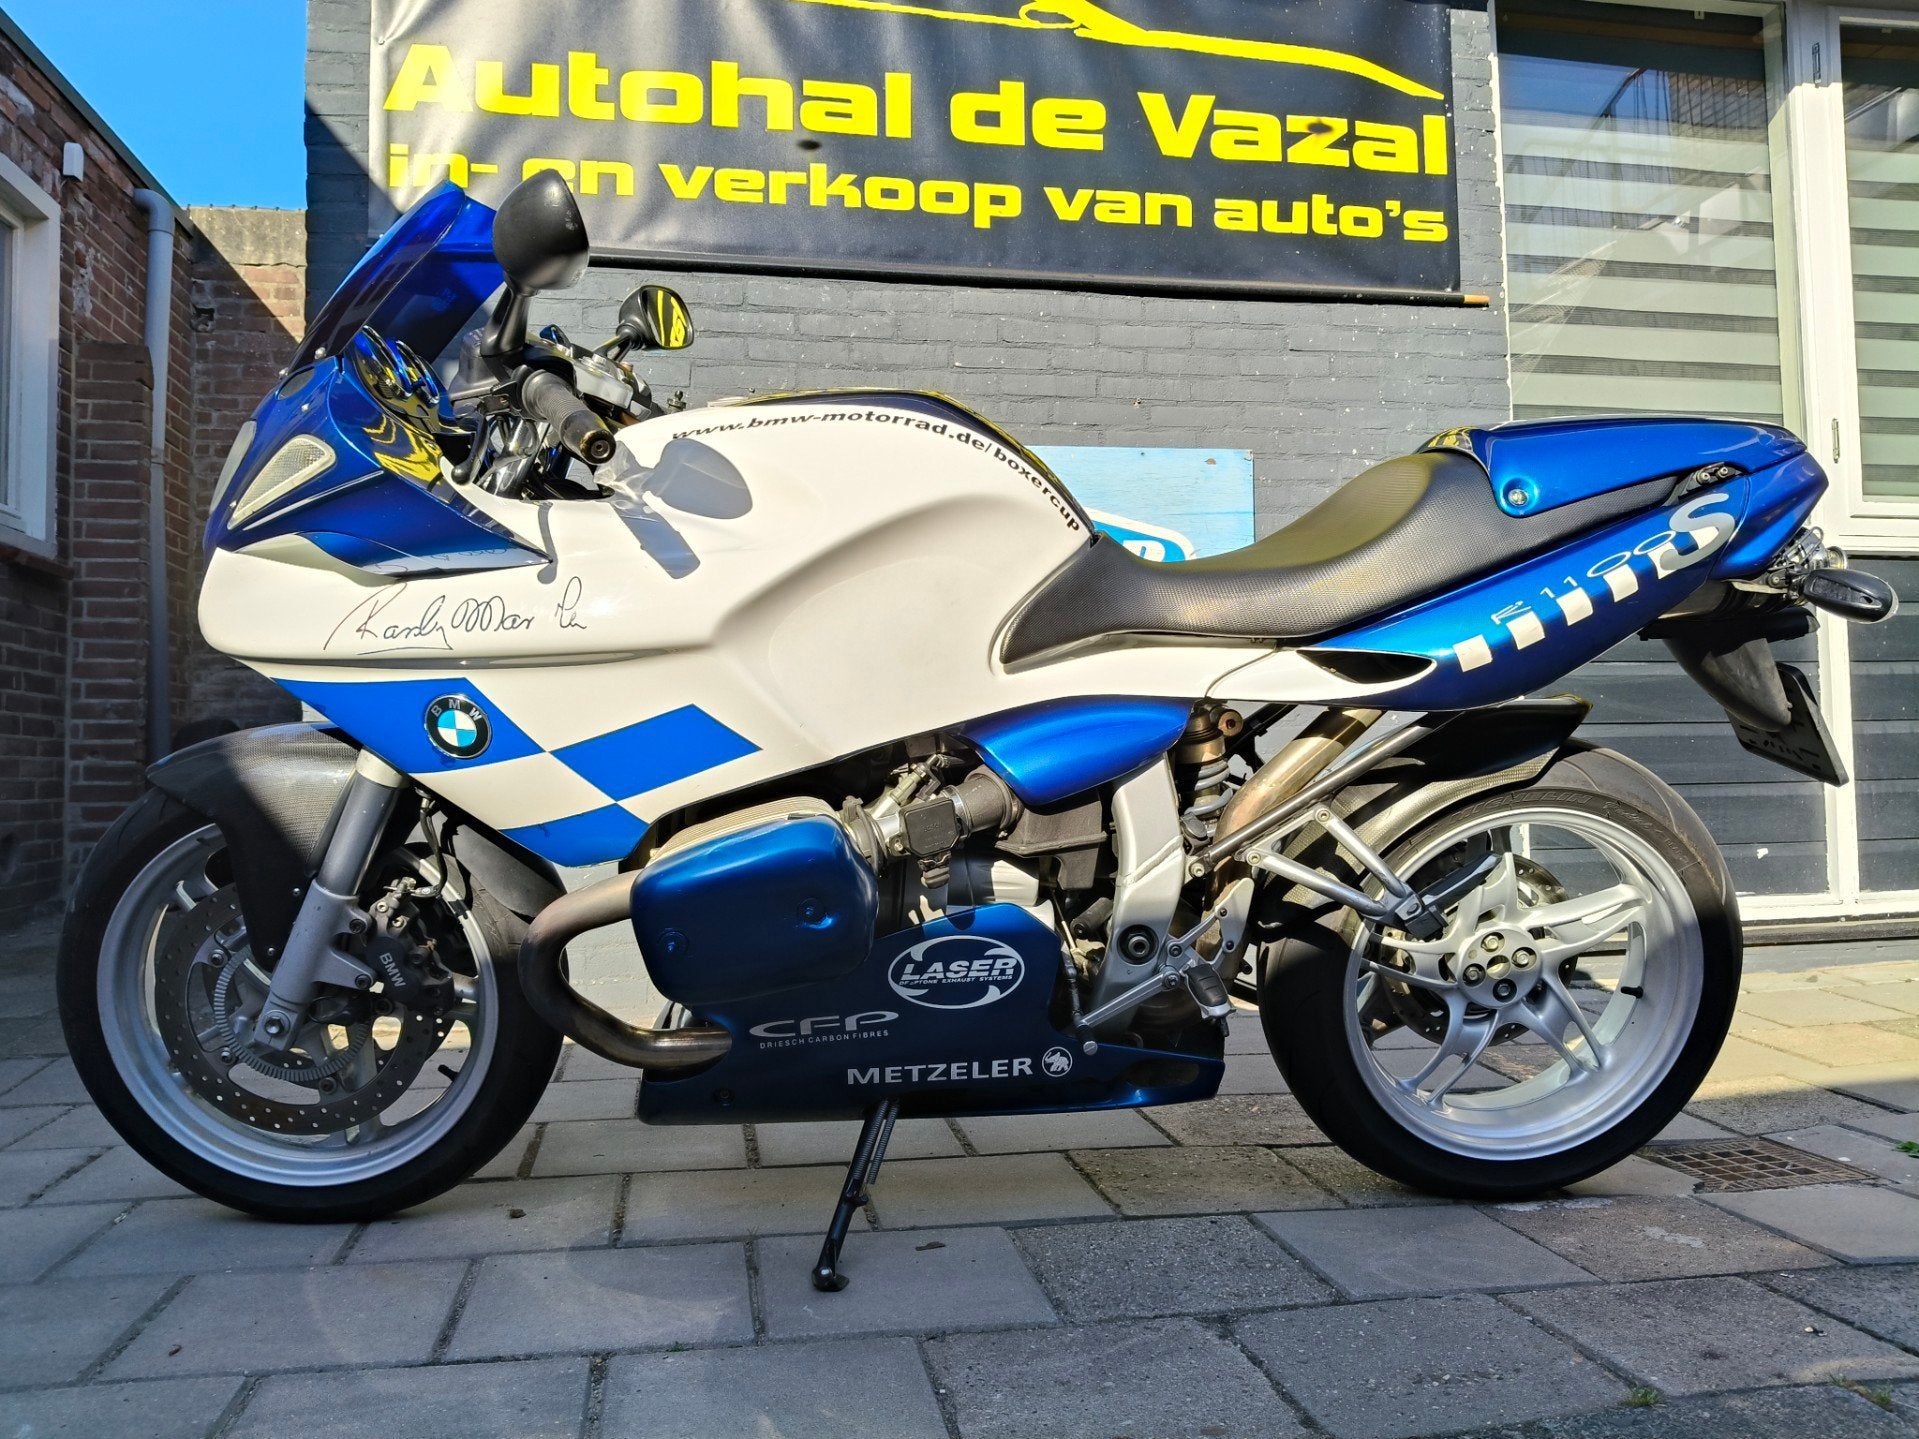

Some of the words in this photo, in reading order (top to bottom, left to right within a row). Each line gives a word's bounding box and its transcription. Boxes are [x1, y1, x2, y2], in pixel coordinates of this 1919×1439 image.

[384, 44, 912, 138] Autohal
[950, 80, 1106, 151] de
[1138, 92, 1448, 175] Vazal
[389, 143, 499, 189] in-
[659, 163, 1022, 229] verkoop
[1044, 187, 1193, 228] van
[1213, 194, 1449, 242] auto's
[673, 410, 1080, 533] www.bmw-motorrad.de/boxercup
[431, 699, 482, 721] BMW
[380, 952, 406, 987] BMW
[900, 958, 1017, 981] LASER
[979, 974, 1013, 982] SYSTEMS
[749, 1010, 899, 1038] CFP
[760, 1037, 805, 1050] DRIESCH
[808, 1033, 849, 1044] CARBON
[852, 1029, 889, 1040] FIBRES
[848, 1056, 1034, 1085] METZELER
